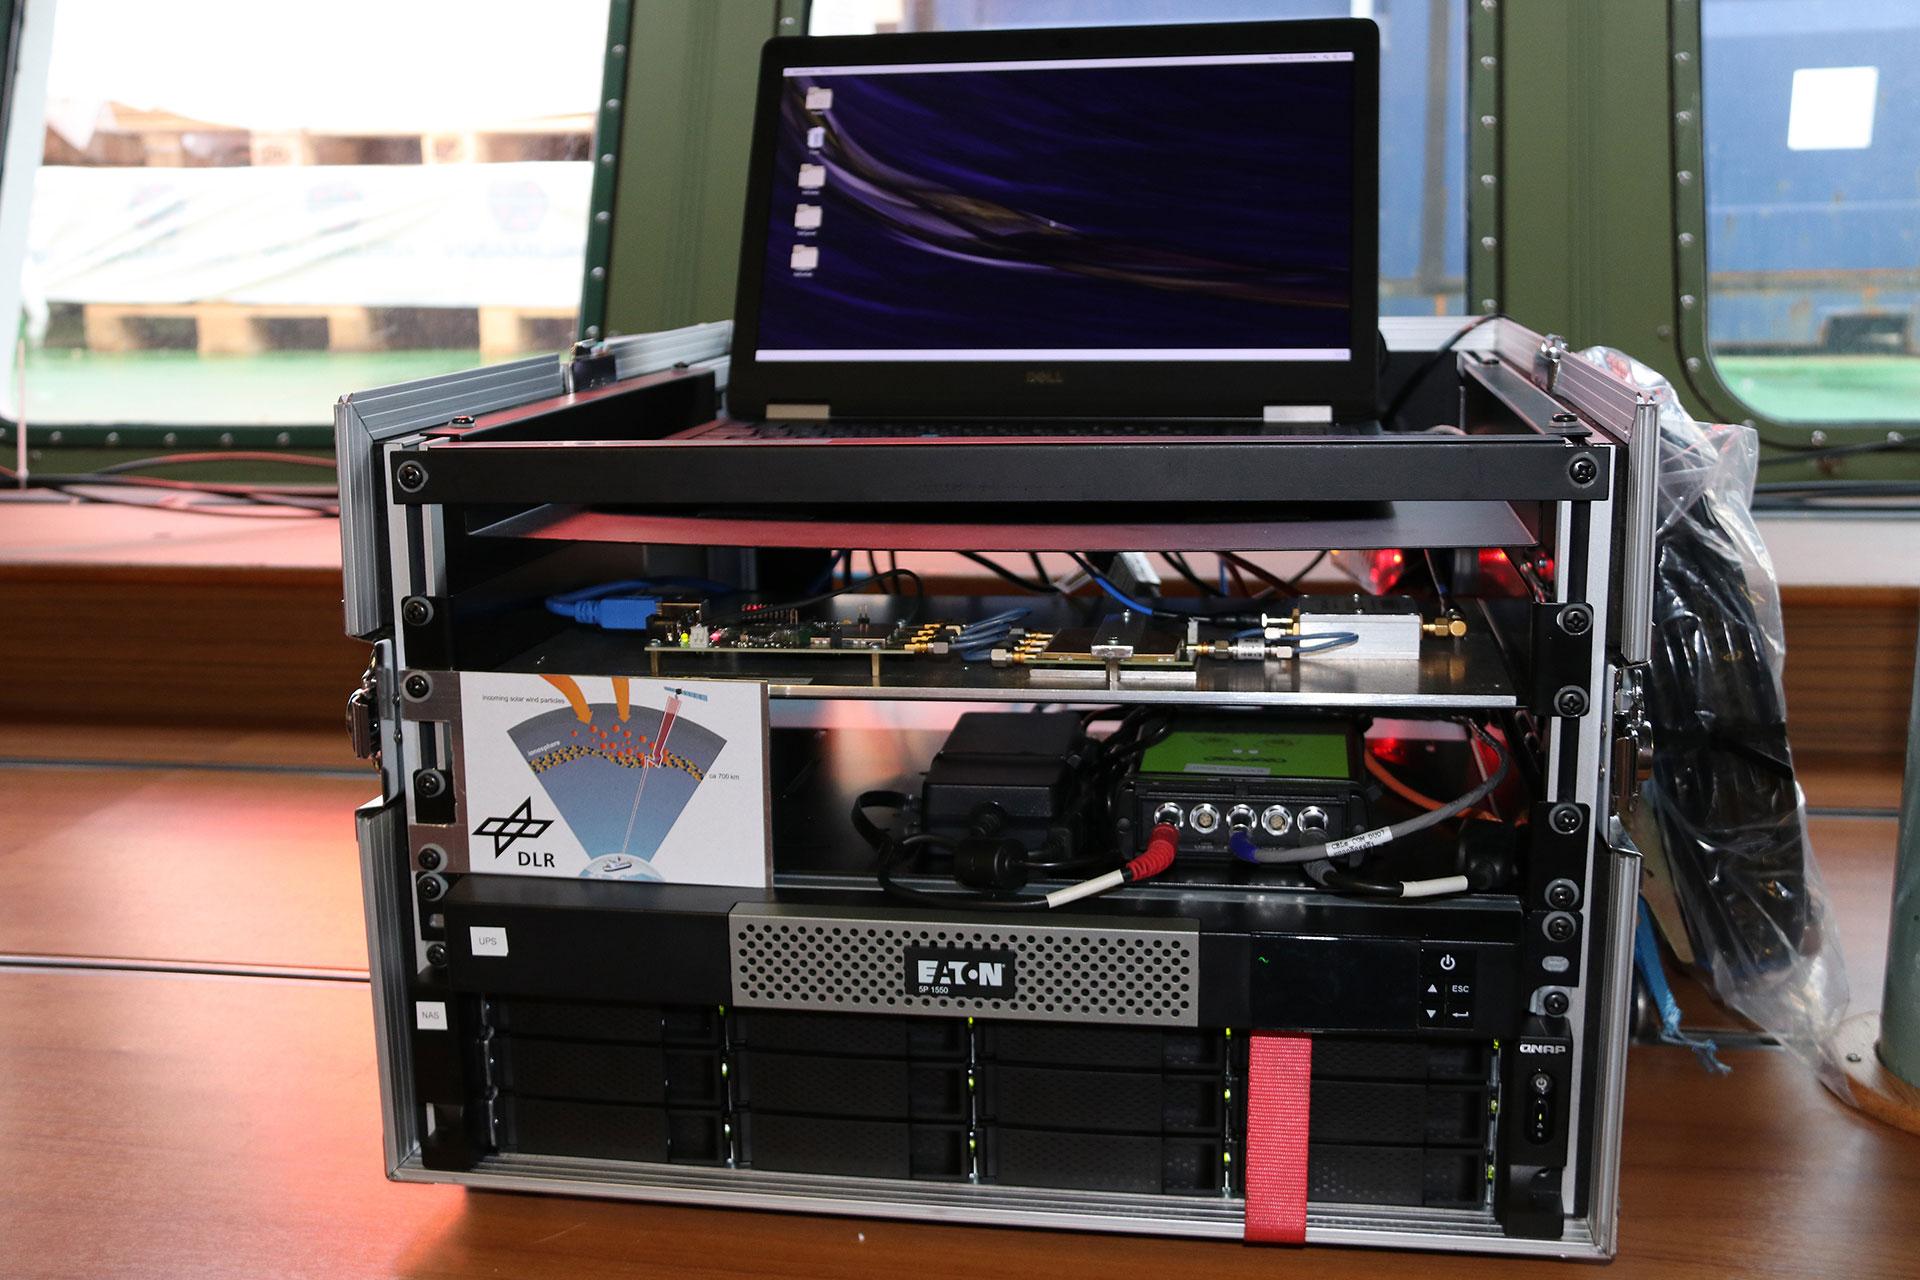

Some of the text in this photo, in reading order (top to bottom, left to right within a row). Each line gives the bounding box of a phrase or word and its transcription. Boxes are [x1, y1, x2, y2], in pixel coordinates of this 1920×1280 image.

[540, 696, 565, 704] particles
[518, 851, 555, 868] DLR
[479, 937, 497, 946] UPS
[918, 960, 1003, 987] EATON
[931, 986, 949, 994] 1550
[1452, 984, 1470, 993] ESC
[422, 1011, 440, 1020] NAS
[1520, 1043, 1567, 1054] QNAP
